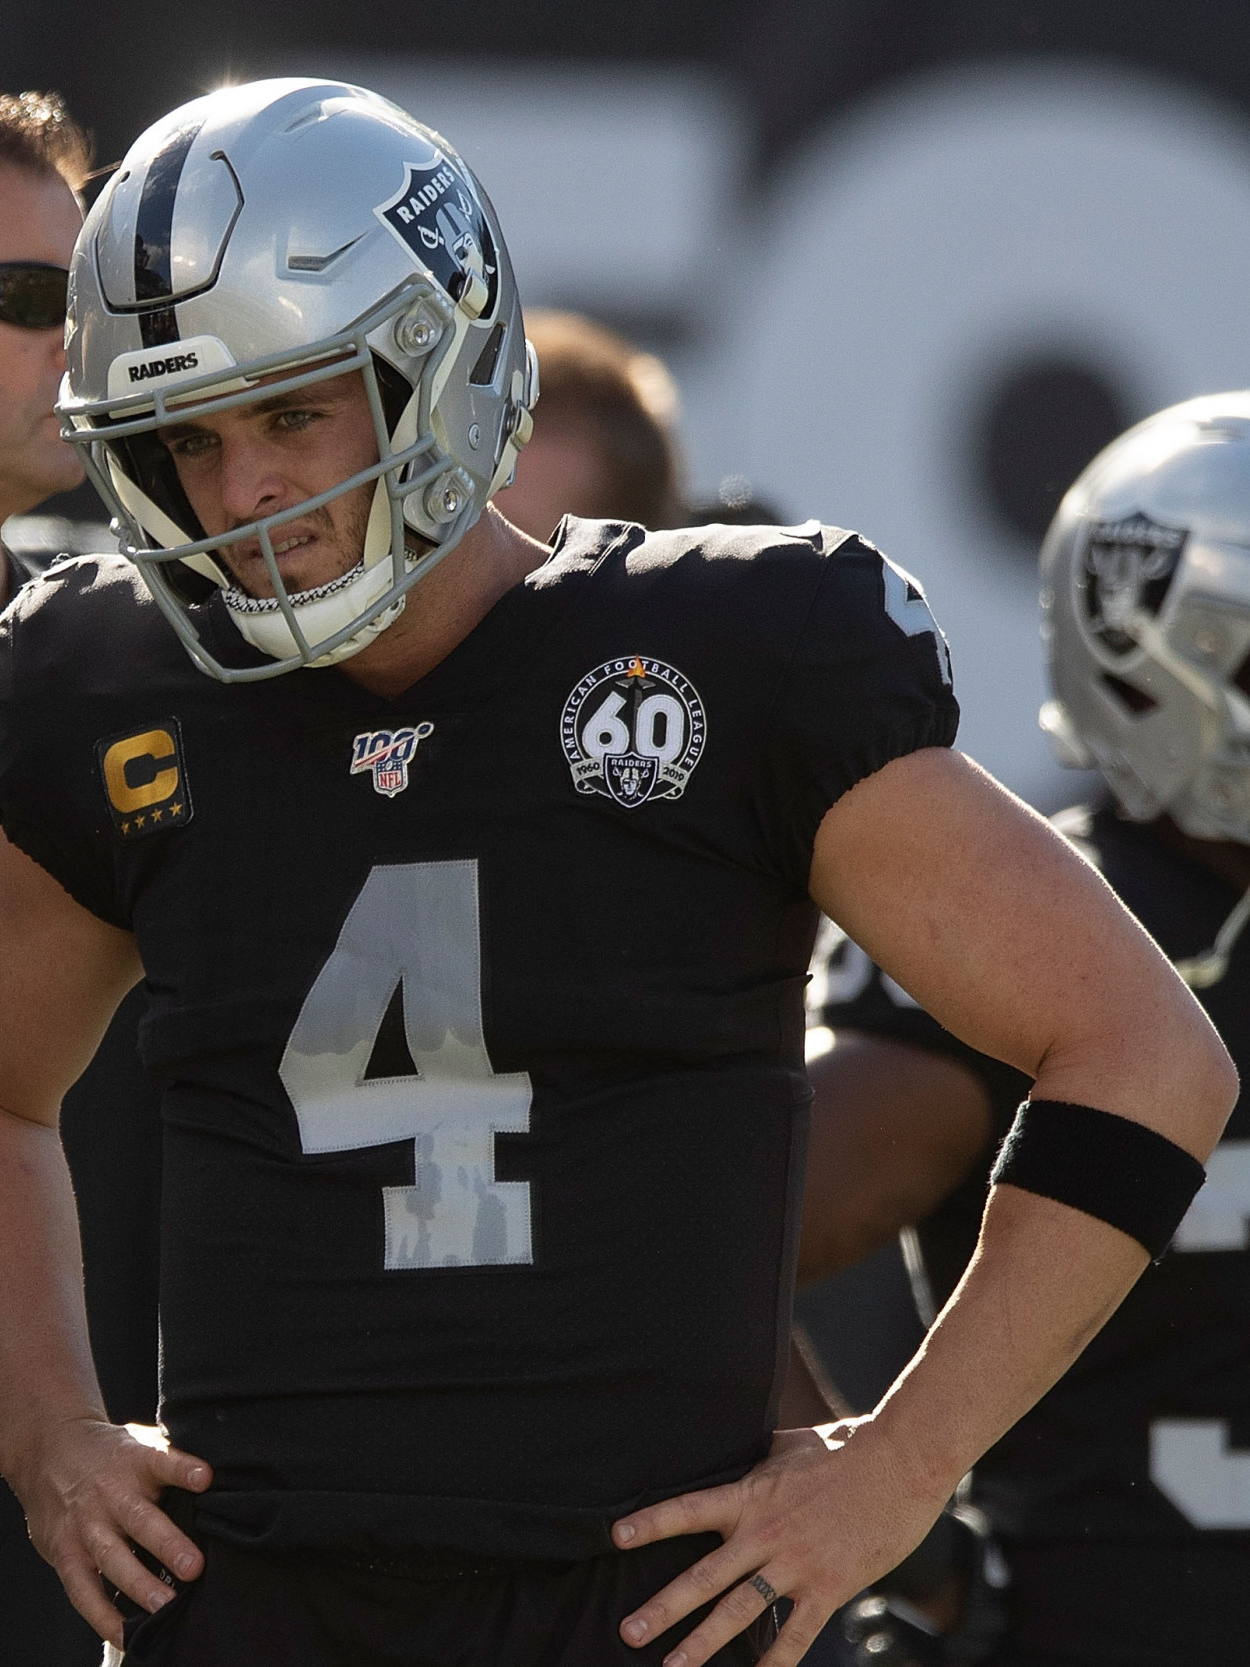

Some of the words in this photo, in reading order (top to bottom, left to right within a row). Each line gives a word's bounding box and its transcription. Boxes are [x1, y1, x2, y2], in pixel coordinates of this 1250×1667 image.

[396, 166, 455, 224] RAIDERS
[128, 352, 199, 382] RAIDERS
[563, 675, 597, 760] AMERICAN
[604, 659, 688, 693] FOOTBALL
[684, 699, 704, 767] LEAGUE
[582, 691, 685, 762] 60
[356, 731, 416, 762] 100
[103, 729, 179, 814] C
[575, 762, 600, 776] 1960
[610, 758, 652, 769] RAIDERS
[663, 766, 685, 782] 2019
[379, 771, 402, 788] NFL
[279, 858, 533, 1270] 4
